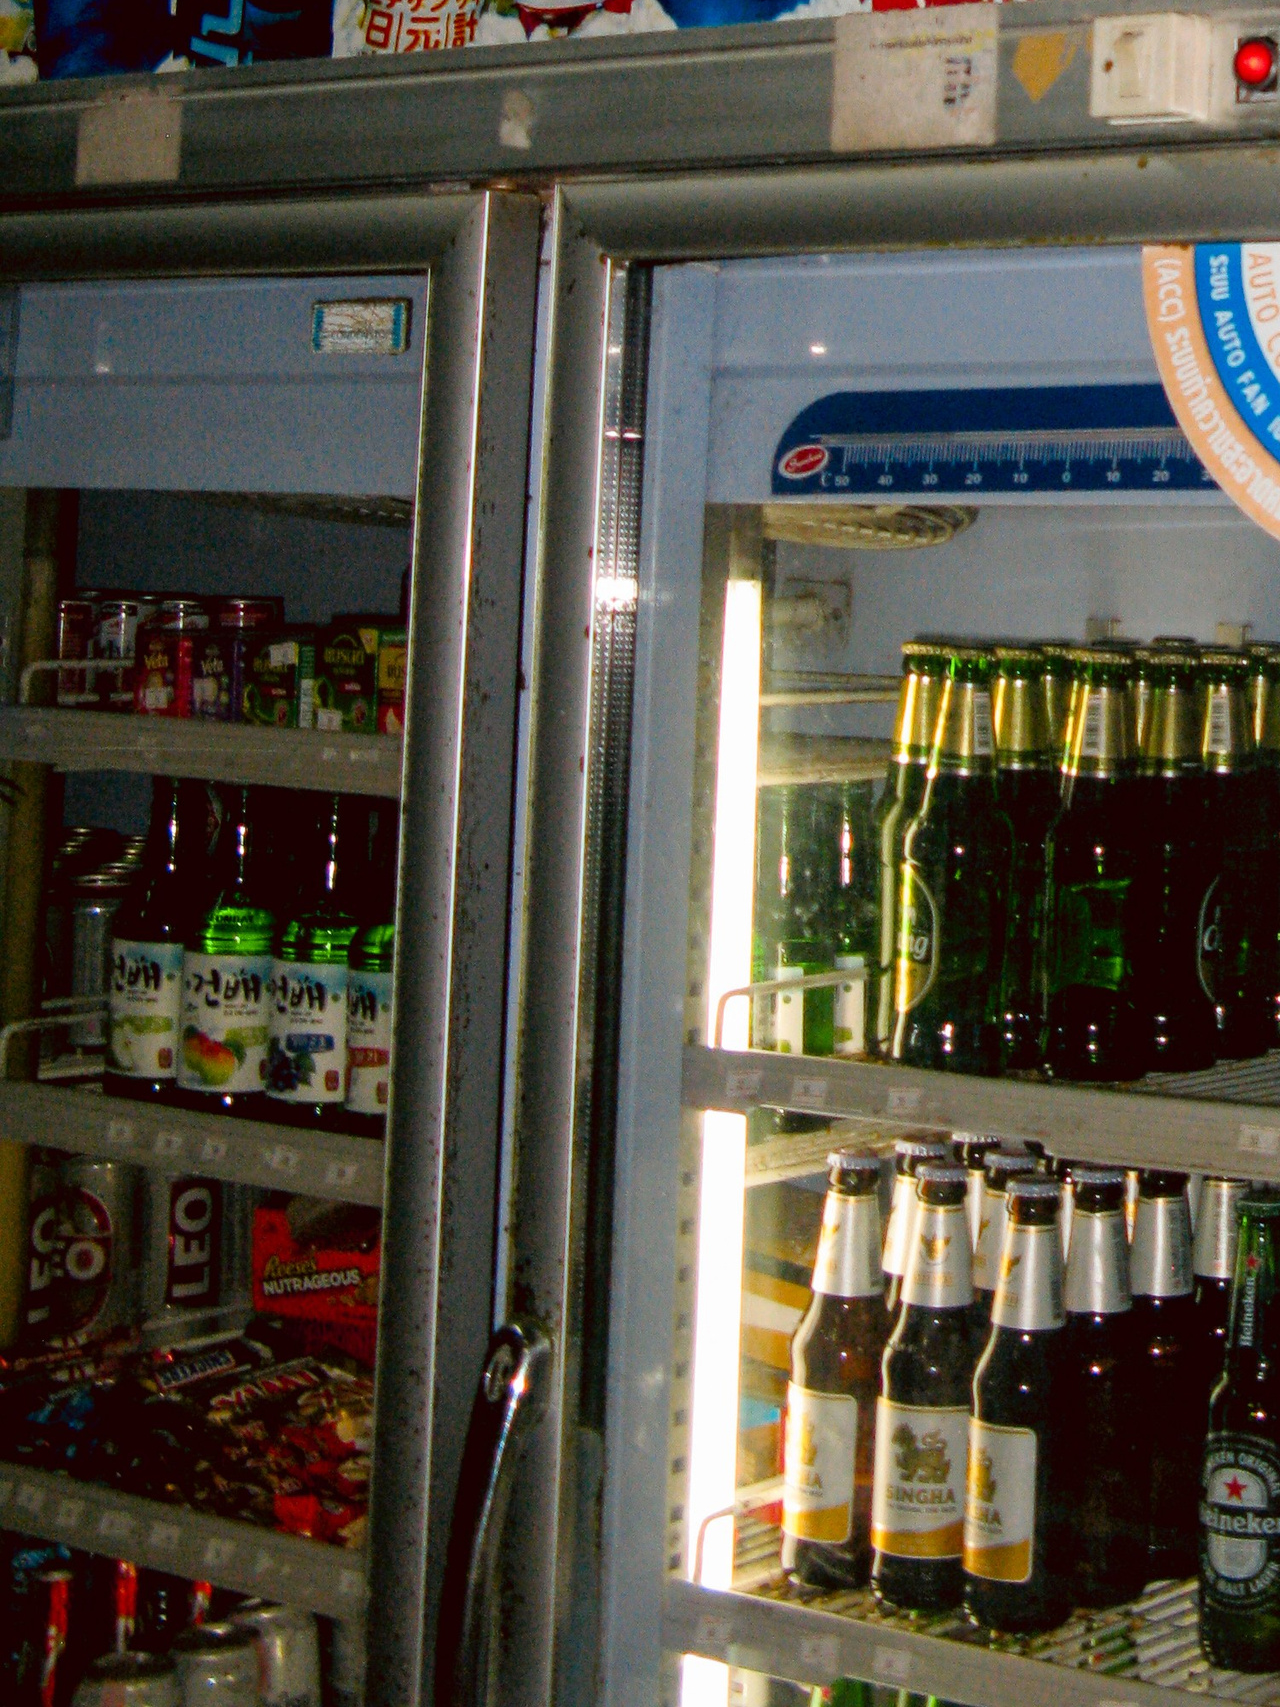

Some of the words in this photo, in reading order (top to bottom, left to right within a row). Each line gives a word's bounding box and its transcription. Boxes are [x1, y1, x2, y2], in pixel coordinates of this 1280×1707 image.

[1248, 252, 1280, 324] AUTO
[1214, 310, 1246, 368] AUTO
[1236, 369, 1271, 416] FAN
[1012, 471, 1028, 484] 10
[1105, 470, 1121, 483] 10
[1152, 469, 1170, 482] 20
[171, 1186, 214, 1300] LEO
[262, 1267, 363, 1297] NUTRAGEOUS
[1238, 1276, 1257, 1347] Heineken
[886, 1487, 957, 1506] SINGHA
